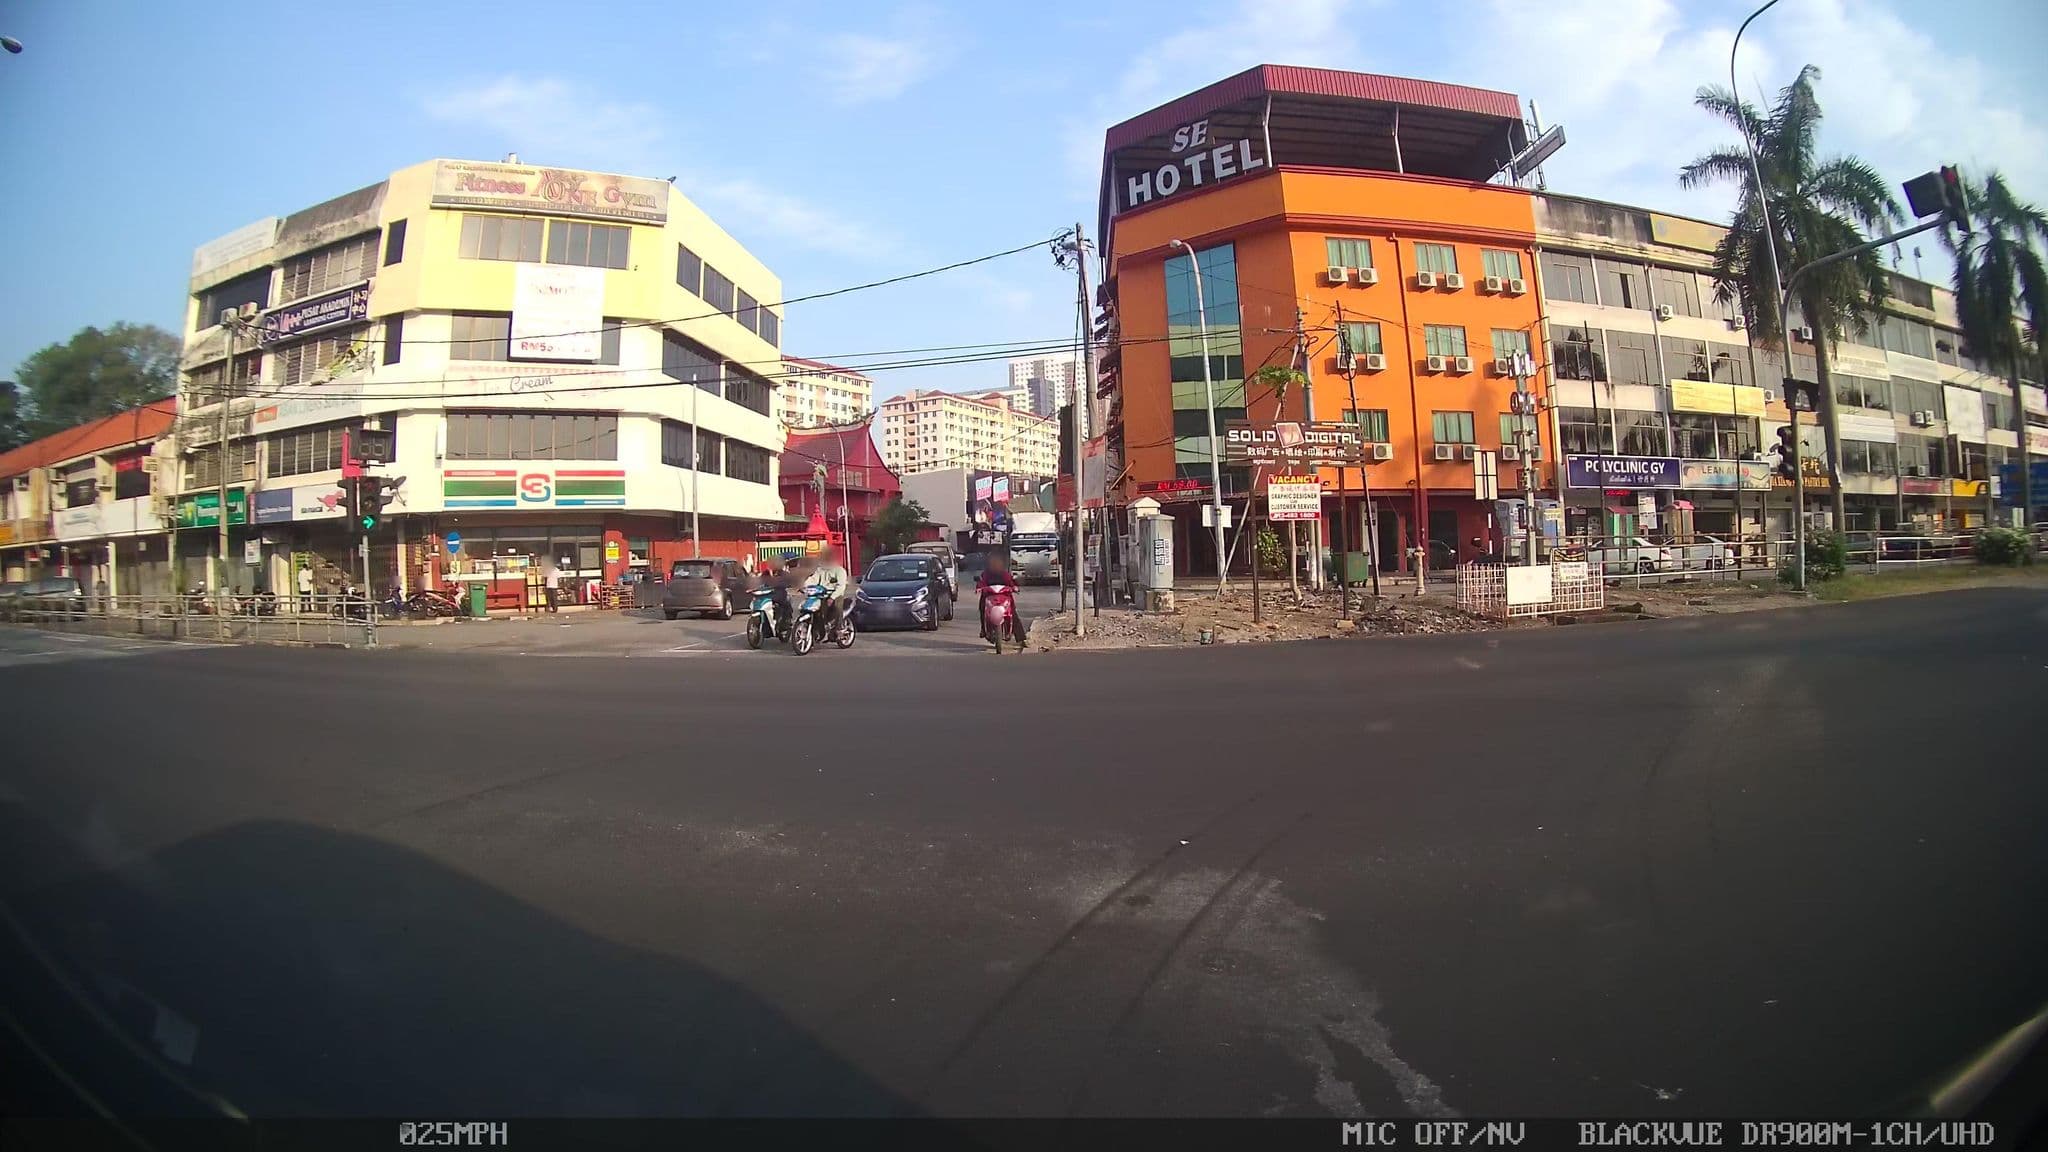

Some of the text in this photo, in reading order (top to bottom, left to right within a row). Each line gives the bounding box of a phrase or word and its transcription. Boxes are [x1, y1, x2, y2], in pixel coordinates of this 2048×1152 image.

[1170, 118, 1209, 153] SE
[1127, 138, 1265, 207] HOTEL
[604, 185, 657, 209] Gym
[510, 375, 554, 393] Cream
[1228, 429, 1361, 445] SOLID DIGITAL
[1585, 459, 1665, 474] POLYCLINIC GY
[1271, 475, 1316, 484] VACANCY
